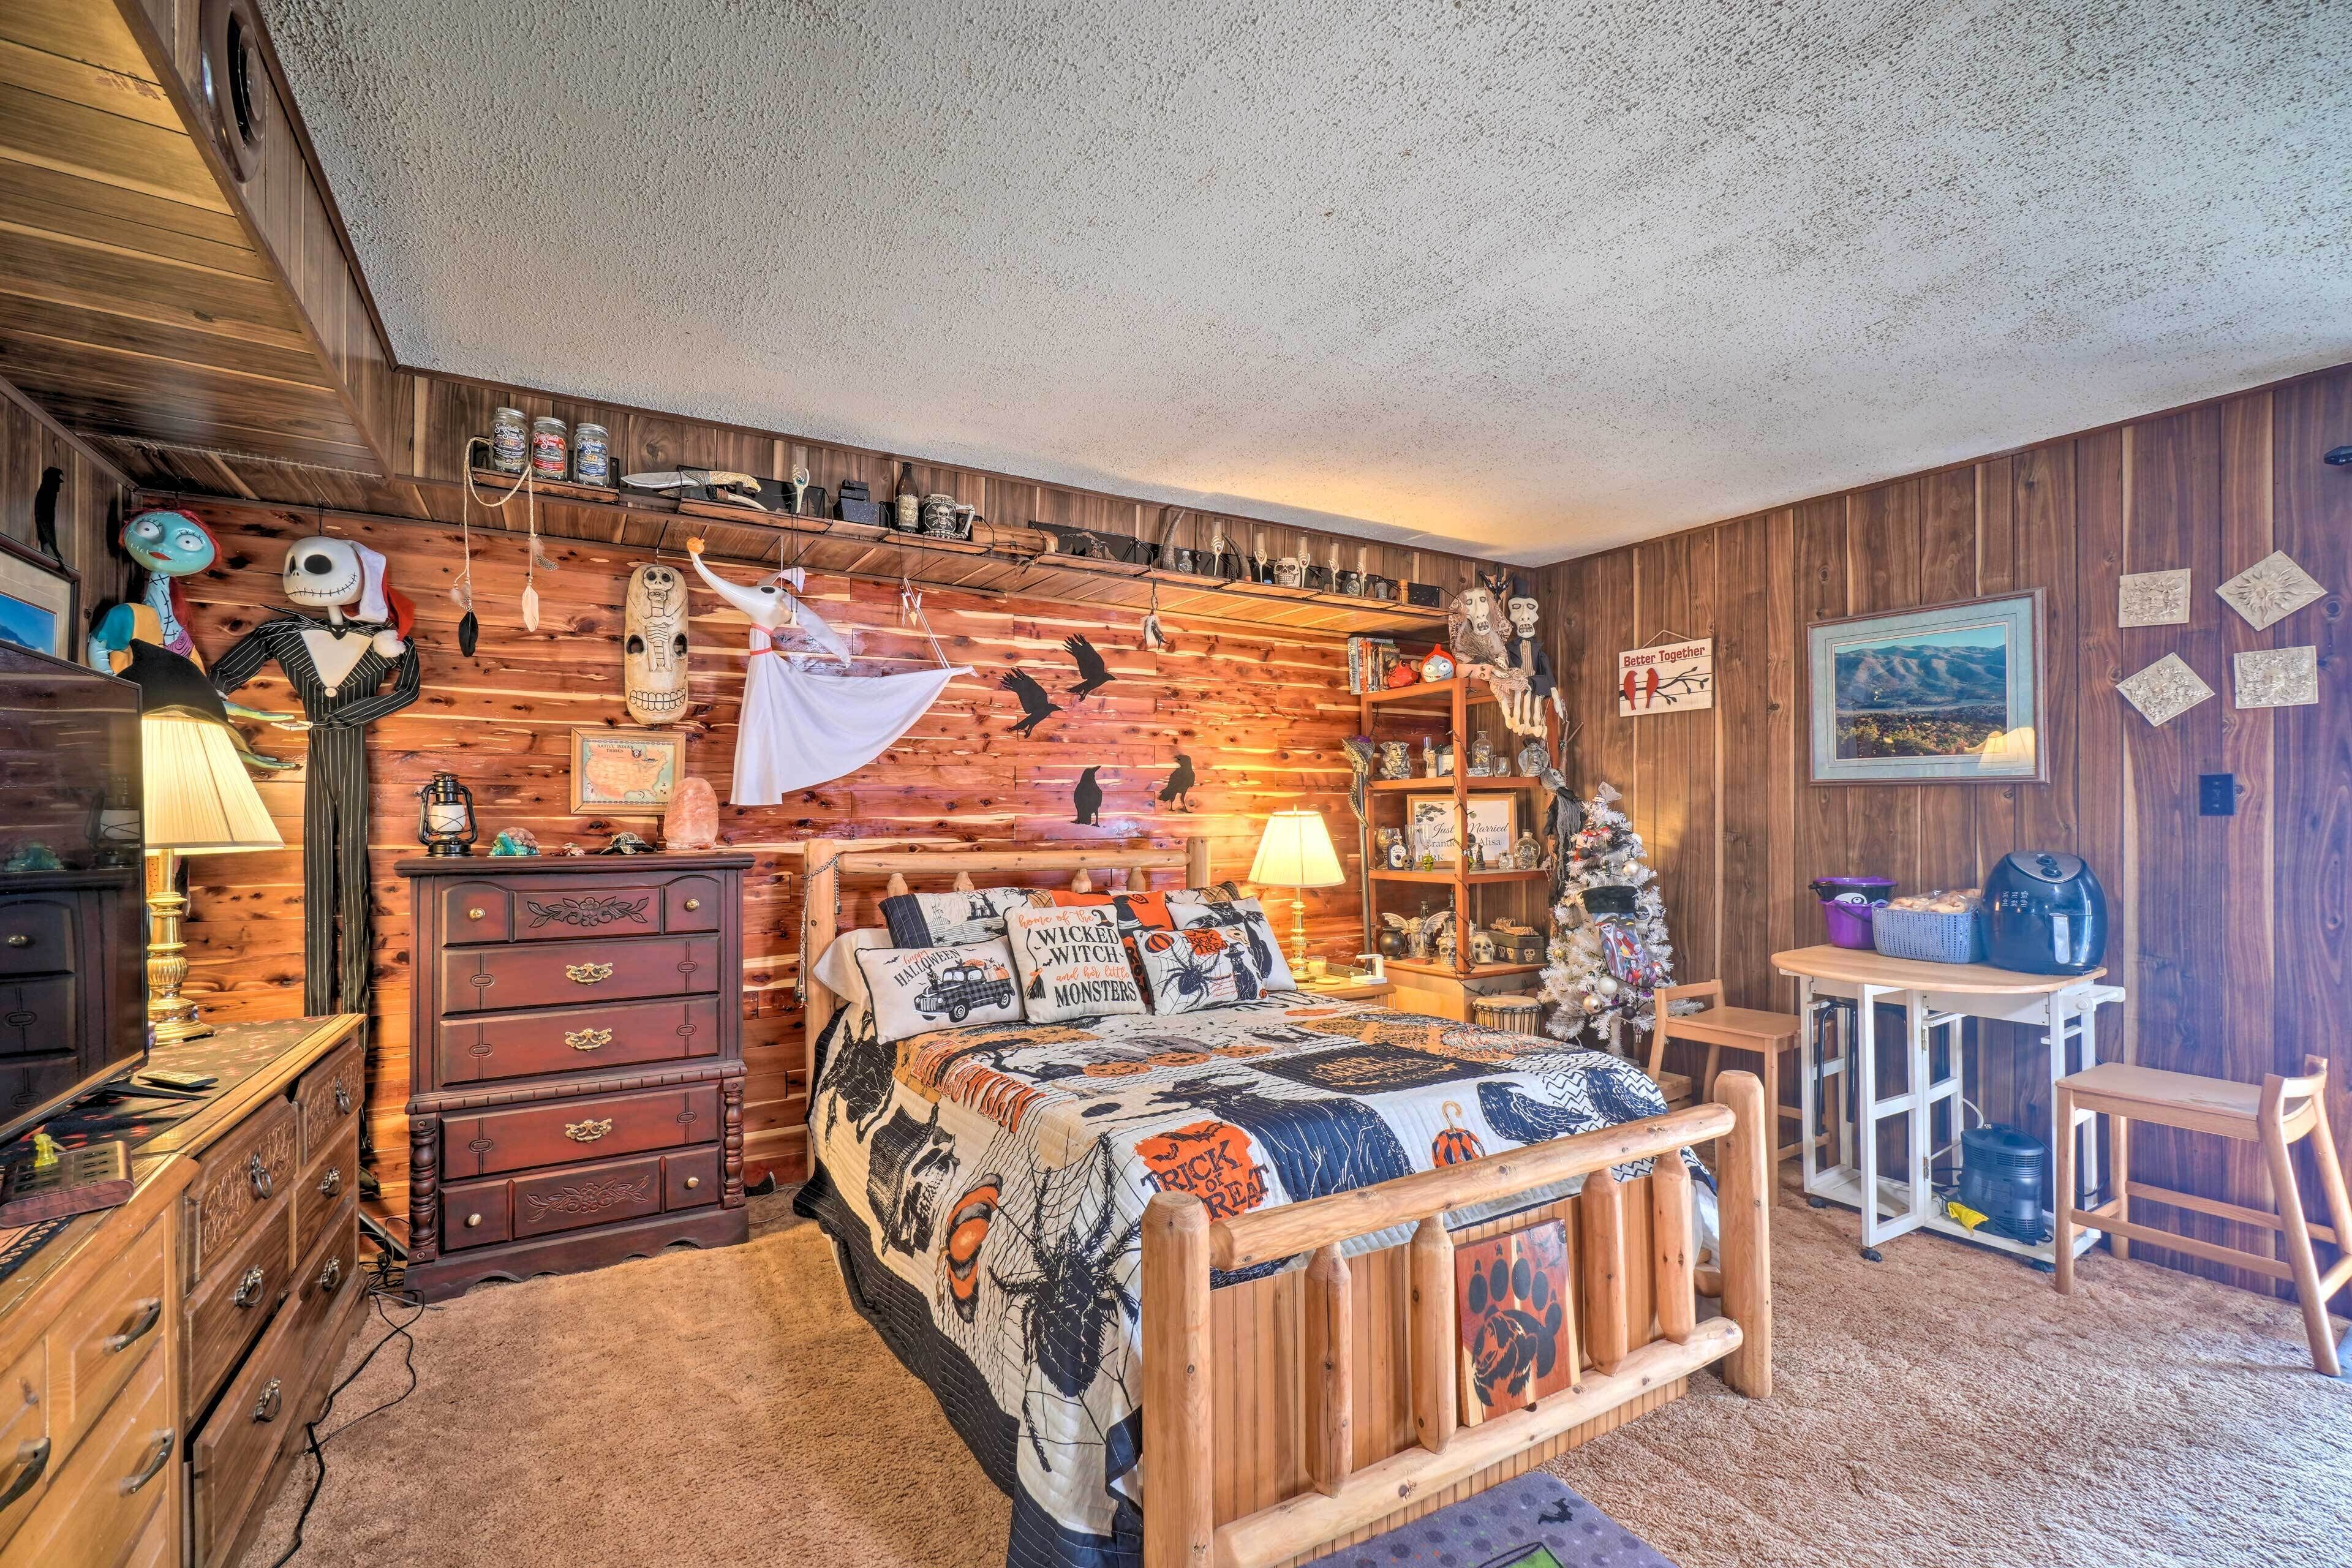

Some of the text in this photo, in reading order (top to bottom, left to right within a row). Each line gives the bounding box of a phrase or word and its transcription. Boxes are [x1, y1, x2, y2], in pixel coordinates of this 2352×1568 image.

[502, 430, 518, 439] Shine
[541, 439, 557, 449] Shine
[585, 445, 600, 454] Shine
[1624, 646, 1705, 668] Better Together
[1480, 837, 1501, 846] Alisa
[1018, 910, 1094, 929] home of the
[1036, 925, 1120, 946] WICKED
[903, 950, 929, 965] happy
[1049, 945, 1120, 966] WITCH
[894, 949, 961, 987] HALLOWEEN
[1055, 965, 1129, 982] and her little
[1054, 980, 1137, 1008] MONSTERS
[1140, 1139, 1243, 1193] TRICK
[1196, 1164, 1270, 1221] REAT
